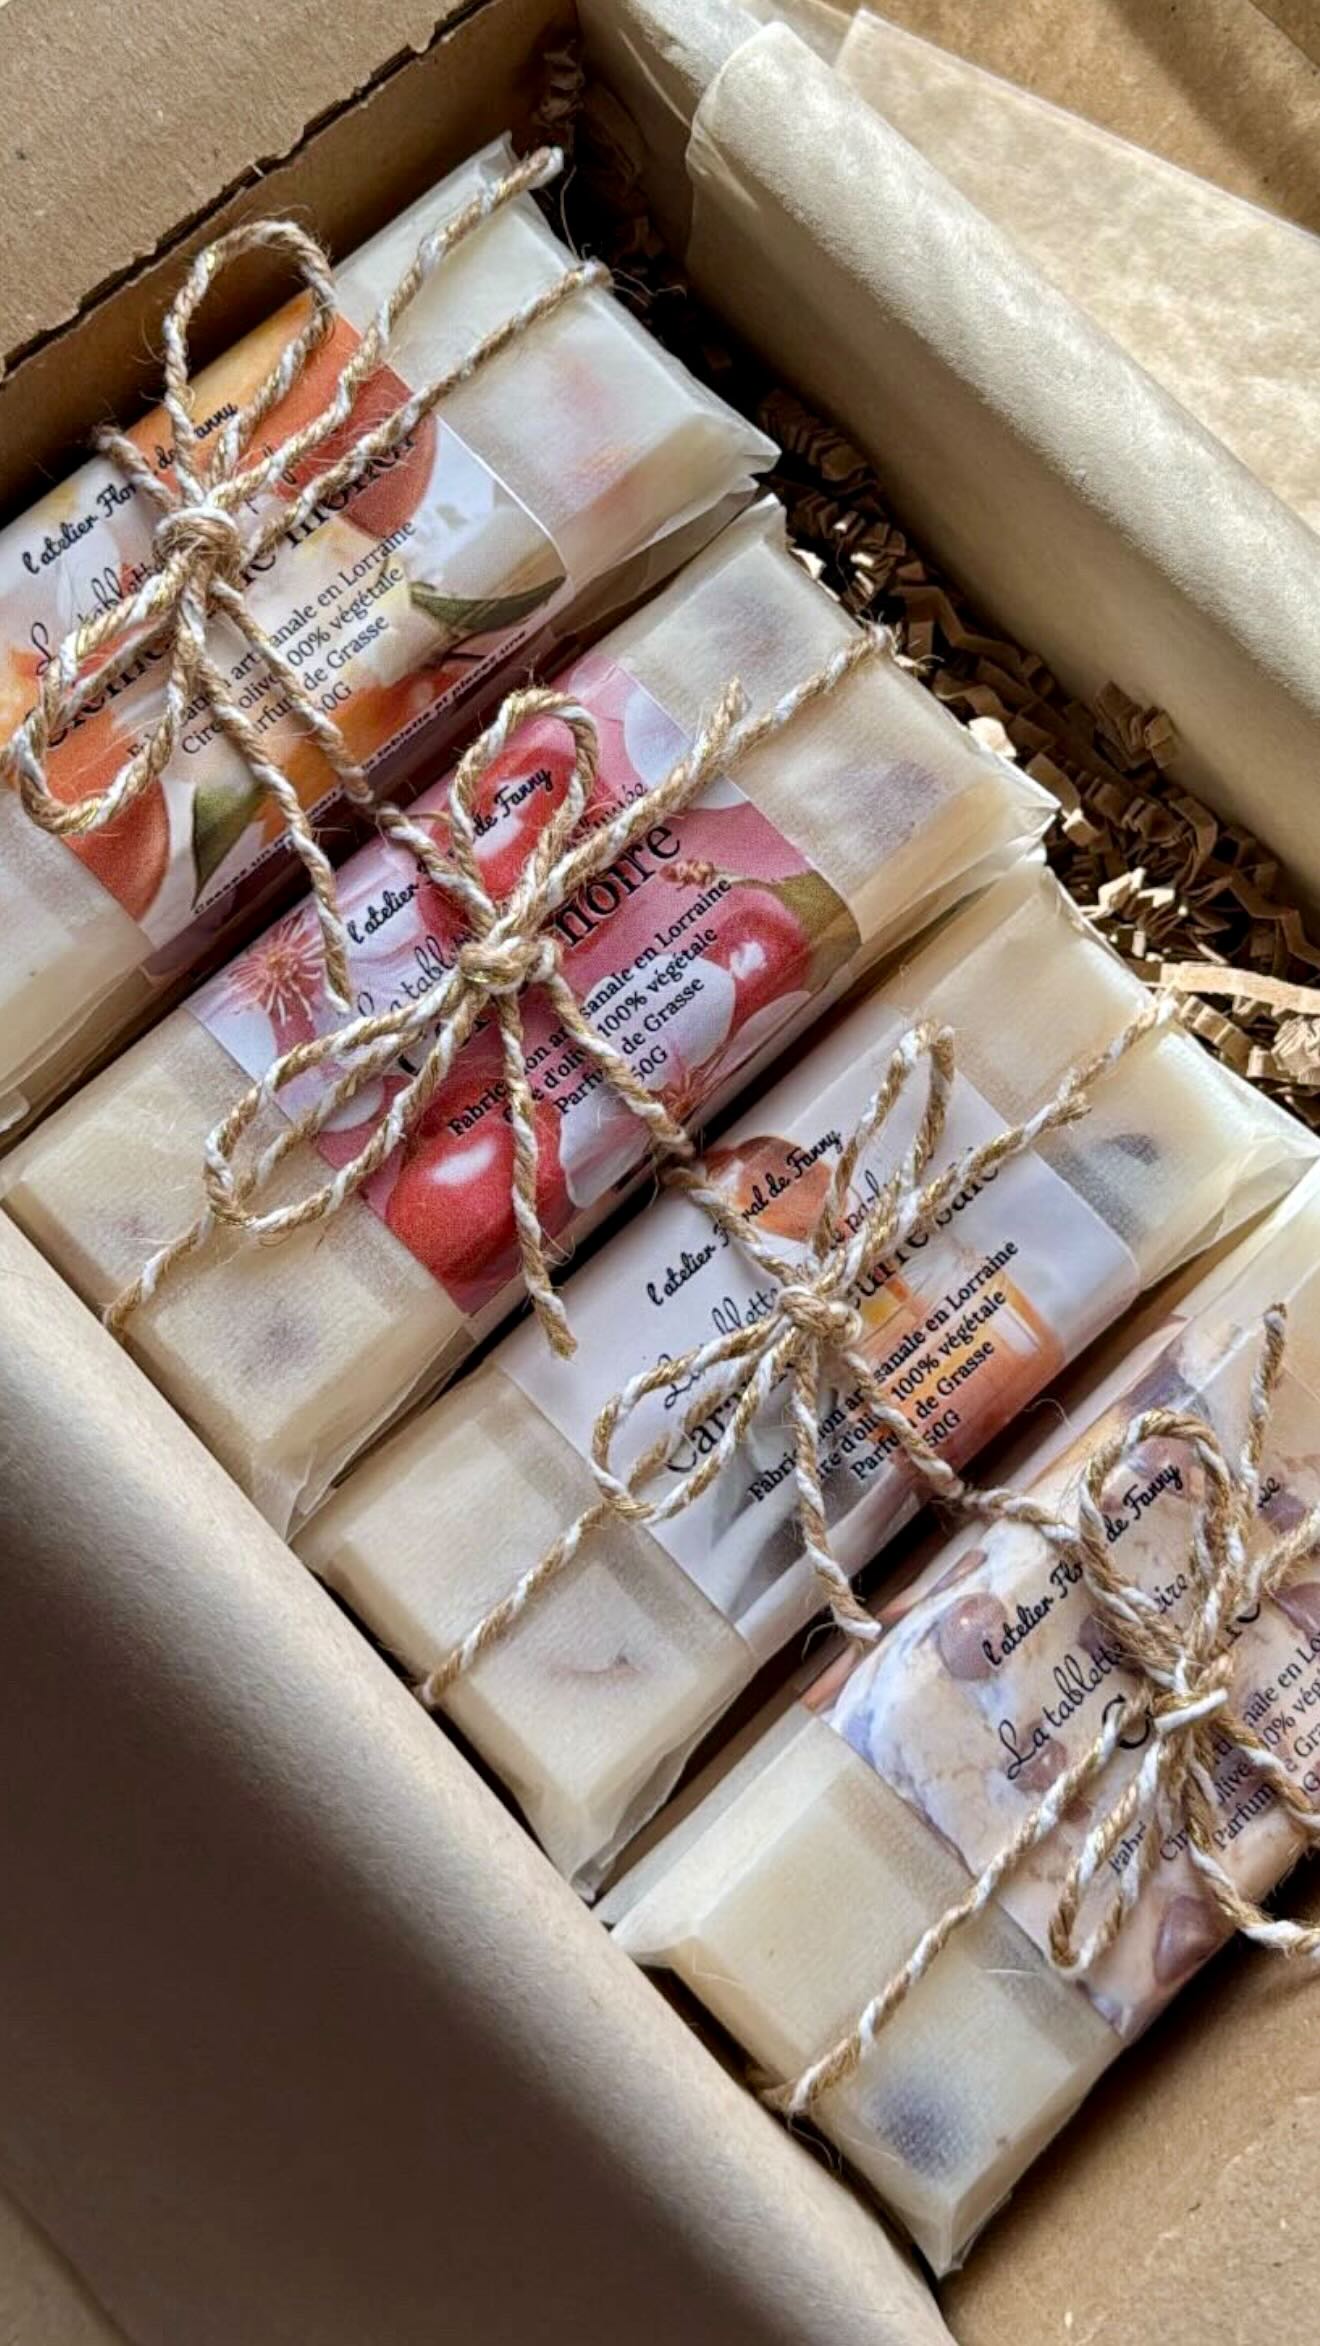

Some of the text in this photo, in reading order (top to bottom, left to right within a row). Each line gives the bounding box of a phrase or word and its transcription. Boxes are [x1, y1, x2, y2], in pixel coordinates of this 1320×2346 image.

[317, 583, 344, 606] en
[338, 521, 417, 587] Lorraine
[286, 626, 332, 667] 00%
[329, 566, 403, 630] végétale
[303, 667, 329, 692] de
[326, 614, 389, 670] Grasse
[376, 710, 431, 758] tablette
[433, 696, 449, 714] et
[452, 655, 497, 698] placez
[473, 812, 498, 838] de
[494, 768, 554, 819] Fanny
[553, 825, 682, 948] noire
[548, 971, 635, 1049] arsanale
[634, 945, 660, 971] en
[653, 878, 732, 949] Lorraine
[597, 990, 648, 1039] 100%
[646, 927, 719, 994] végétale
[553, 976, 705, 1116] Parfu de Grasse
[764, 1172, 790, 1199] de
[785, 1129, 843, 1179] Fanny
[844, 1327, 926, 1412] arsanale
[925, 1307, 951, 1333] en
[945, 1240, 1020, 1311] Lorraine
[890, 1353, 940, 1403] 100%
[937, 1289, 1007, 1358] végétale
[915, 1395, 940, 1422] de
[936, 1339, 996, 1397] Grasse
[922, 1408, 962, 1449] 50G
[1102, 1513, 1130, 1544] de
[1122, 1463, 1184, 1521] Fanny
[1277, 1662, 1303, 1689] en
[998, 1717, 1051, 1781] La
